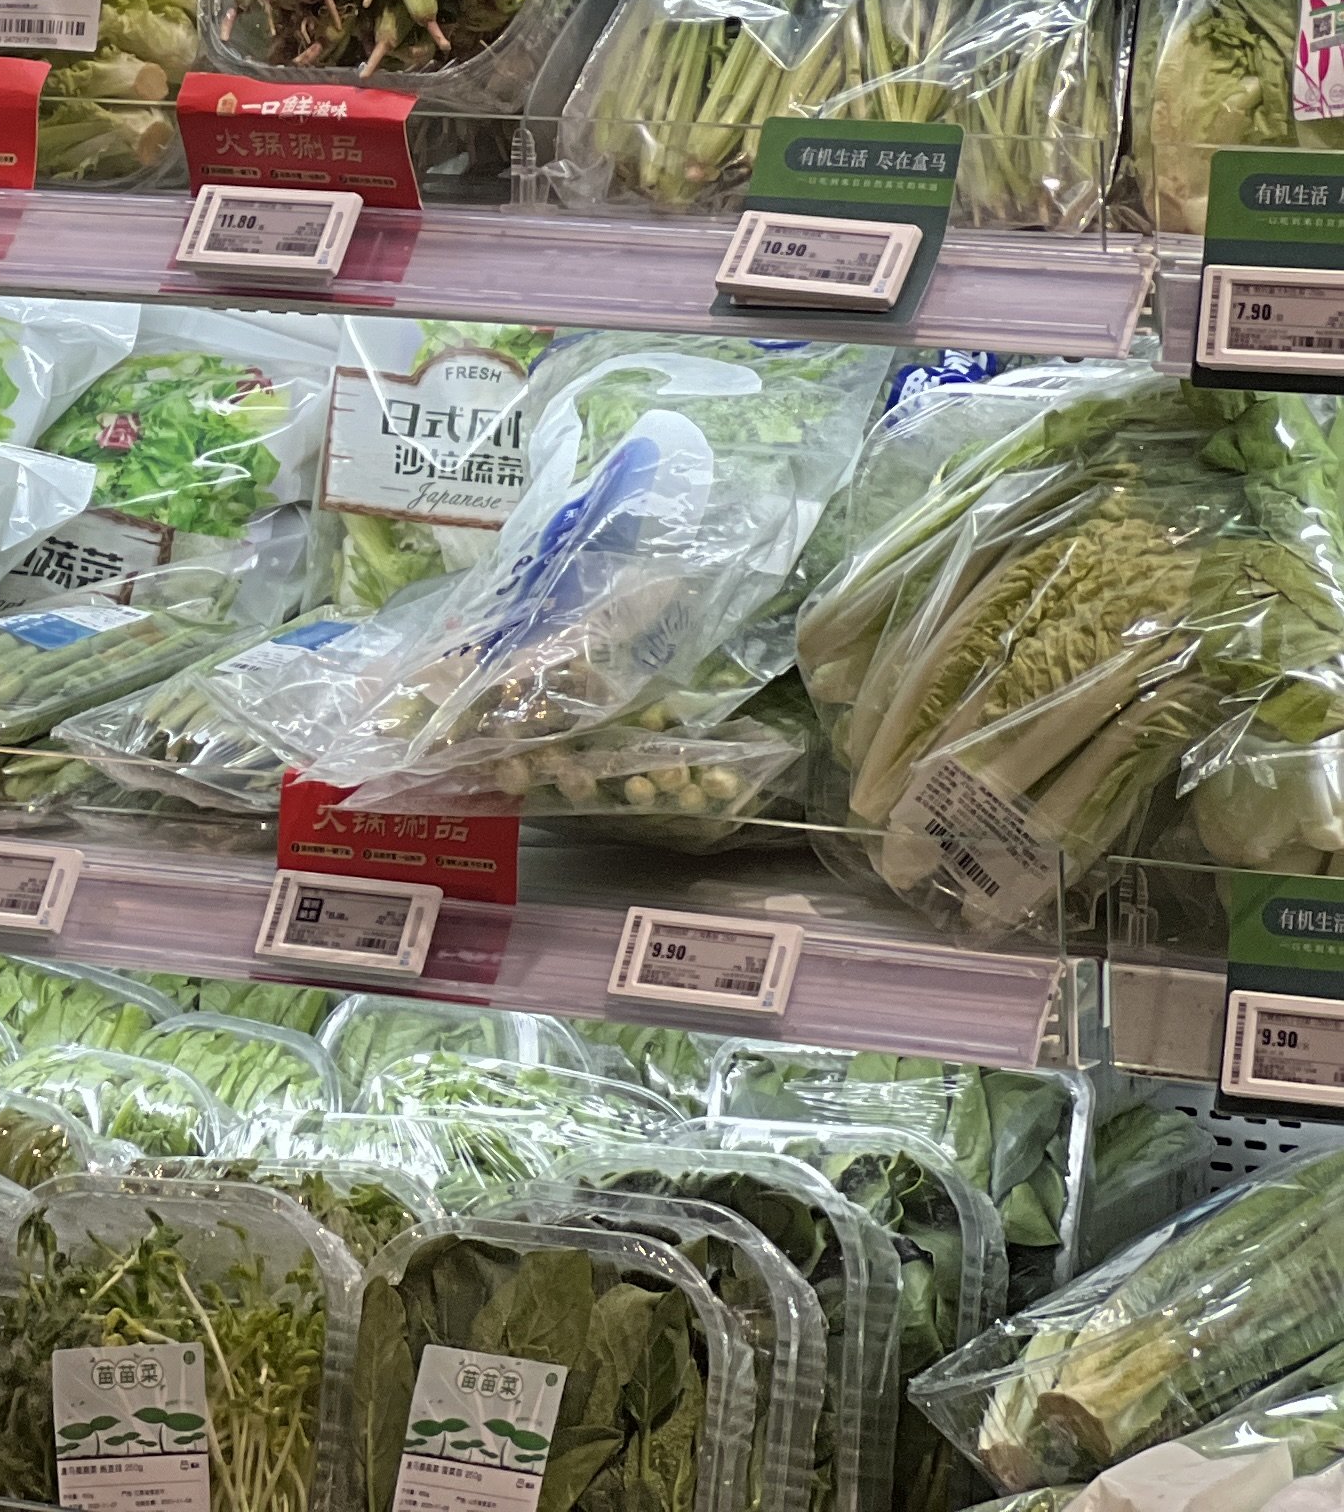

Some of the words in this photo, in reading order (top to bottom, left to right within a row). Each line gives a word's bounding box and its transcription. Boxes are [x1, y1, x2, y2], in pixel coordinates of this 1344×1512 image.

[216, 128, 363, 163] 火锅涮品
[799, 145, 870, 169] 有机生活
[875, 149, 947, 172] 尽在盒马
[1255, 183, 1329, 206] 有机生活
[444, 365, 502, 384] FRESH
[394, 444, 525, 487] 沙拉蔬菜
[406, 481, 503, 512] Japanese
[96, 1360, 160, 1387] 苗苗菜
[460, 1368, 522, 1397] 苗苗菜
